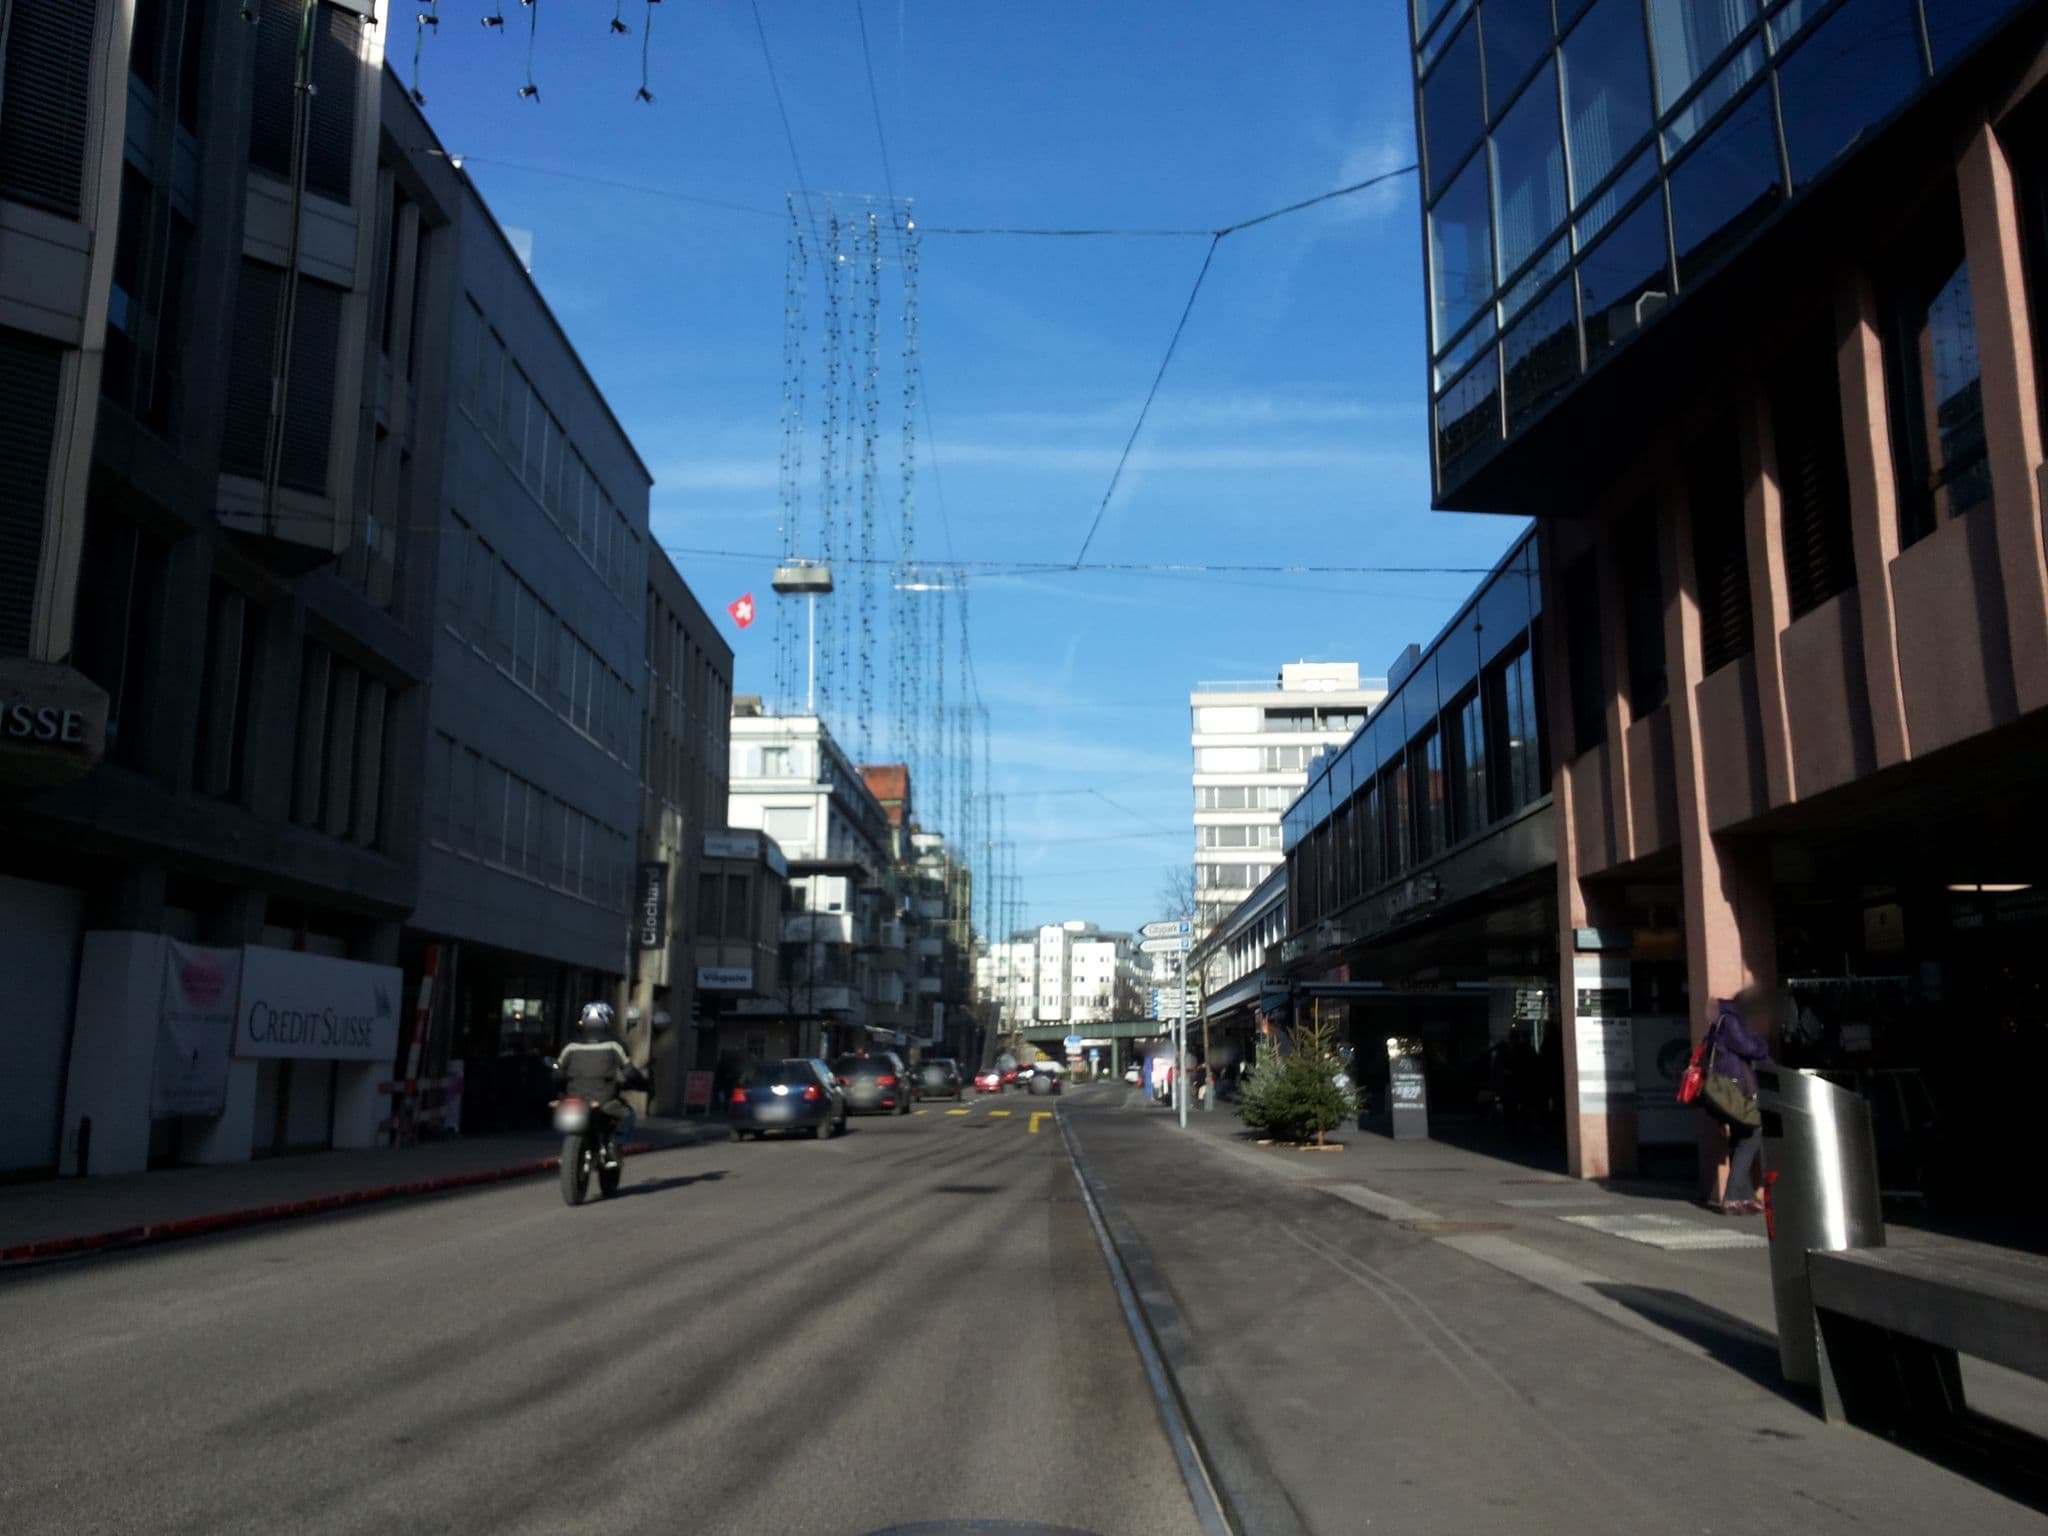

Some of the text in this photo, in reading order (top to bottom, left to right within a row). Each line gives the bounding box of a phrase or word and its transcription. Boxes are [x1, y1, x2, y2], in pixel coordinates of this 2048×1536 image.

[641, 867, 660, 946] Clochard
[249, 1001, 375, 1047] CREDIT SUISSE
